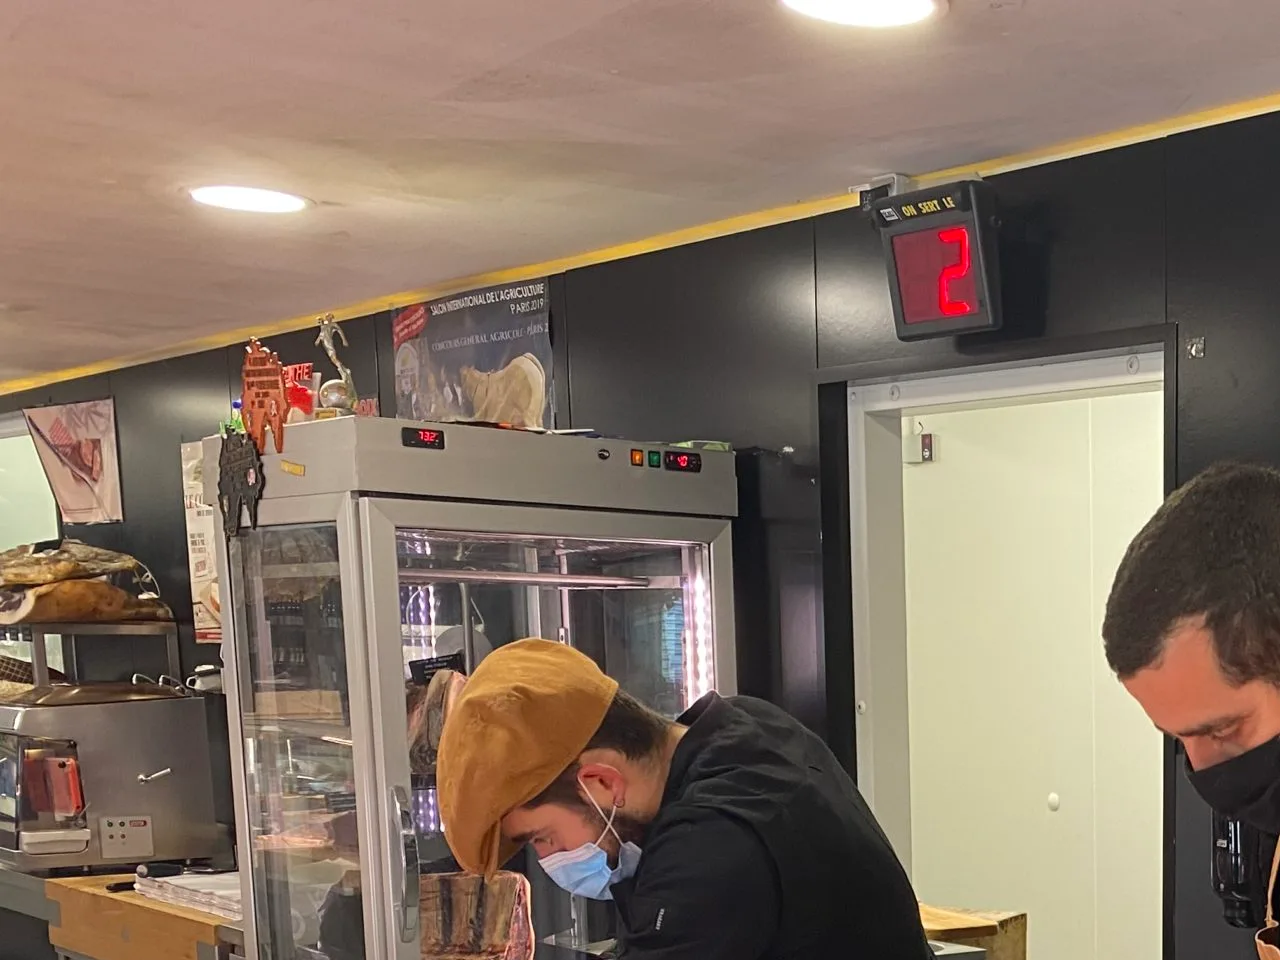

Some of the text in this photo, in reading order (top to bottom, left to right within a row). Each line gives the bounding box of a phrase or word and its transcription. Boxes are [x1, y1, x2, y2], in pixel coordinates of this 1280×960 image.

[902, 197, 955, 216] ON SERT LE
[939, 227, 970, 315] 2
[431, 304, 447, 316] SALON
[447, 295, 486, 312] INTERNATIONAL
[510, 298, 543, 315] PARIS 2019
